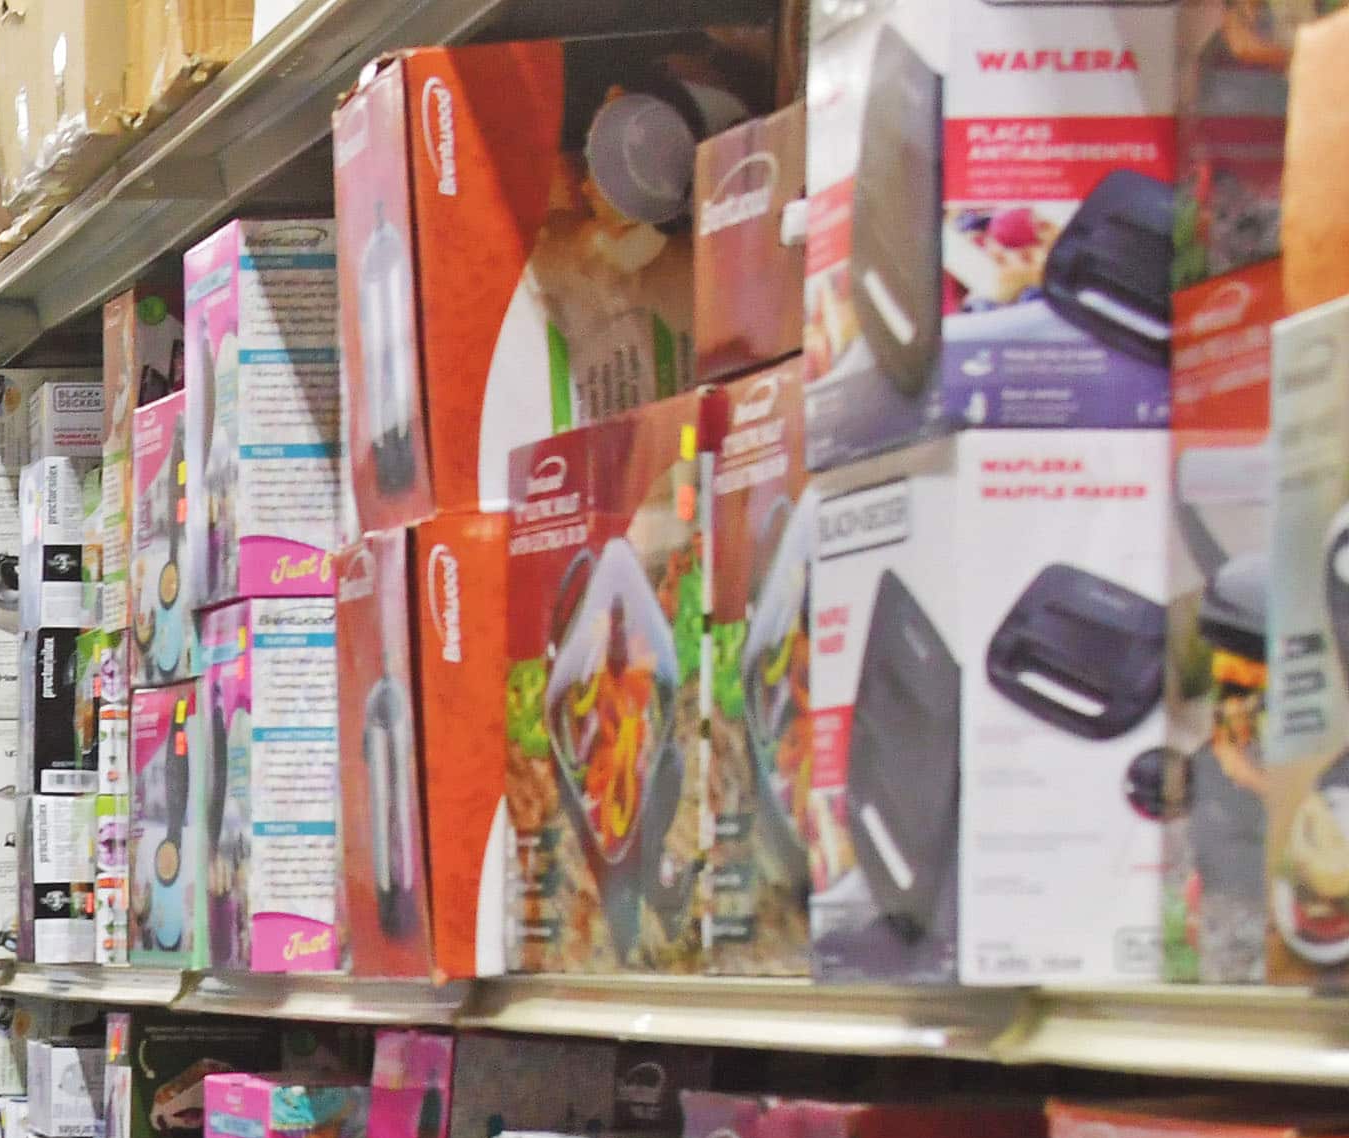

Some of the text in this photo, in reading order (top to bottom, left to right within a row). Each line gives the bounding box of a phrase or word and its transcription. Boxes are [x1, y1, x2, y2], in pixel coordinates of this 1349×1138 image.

[976, 49, 1140, 72] WAFLERA
[430, 80, 457, 196] Brentwood
[1072, 486, 1146, 499] MAKER
[272, 553, 317, 584] Just
[435, 550, 462, 662] Brentwood
[283, 931, 331, 960] Just
